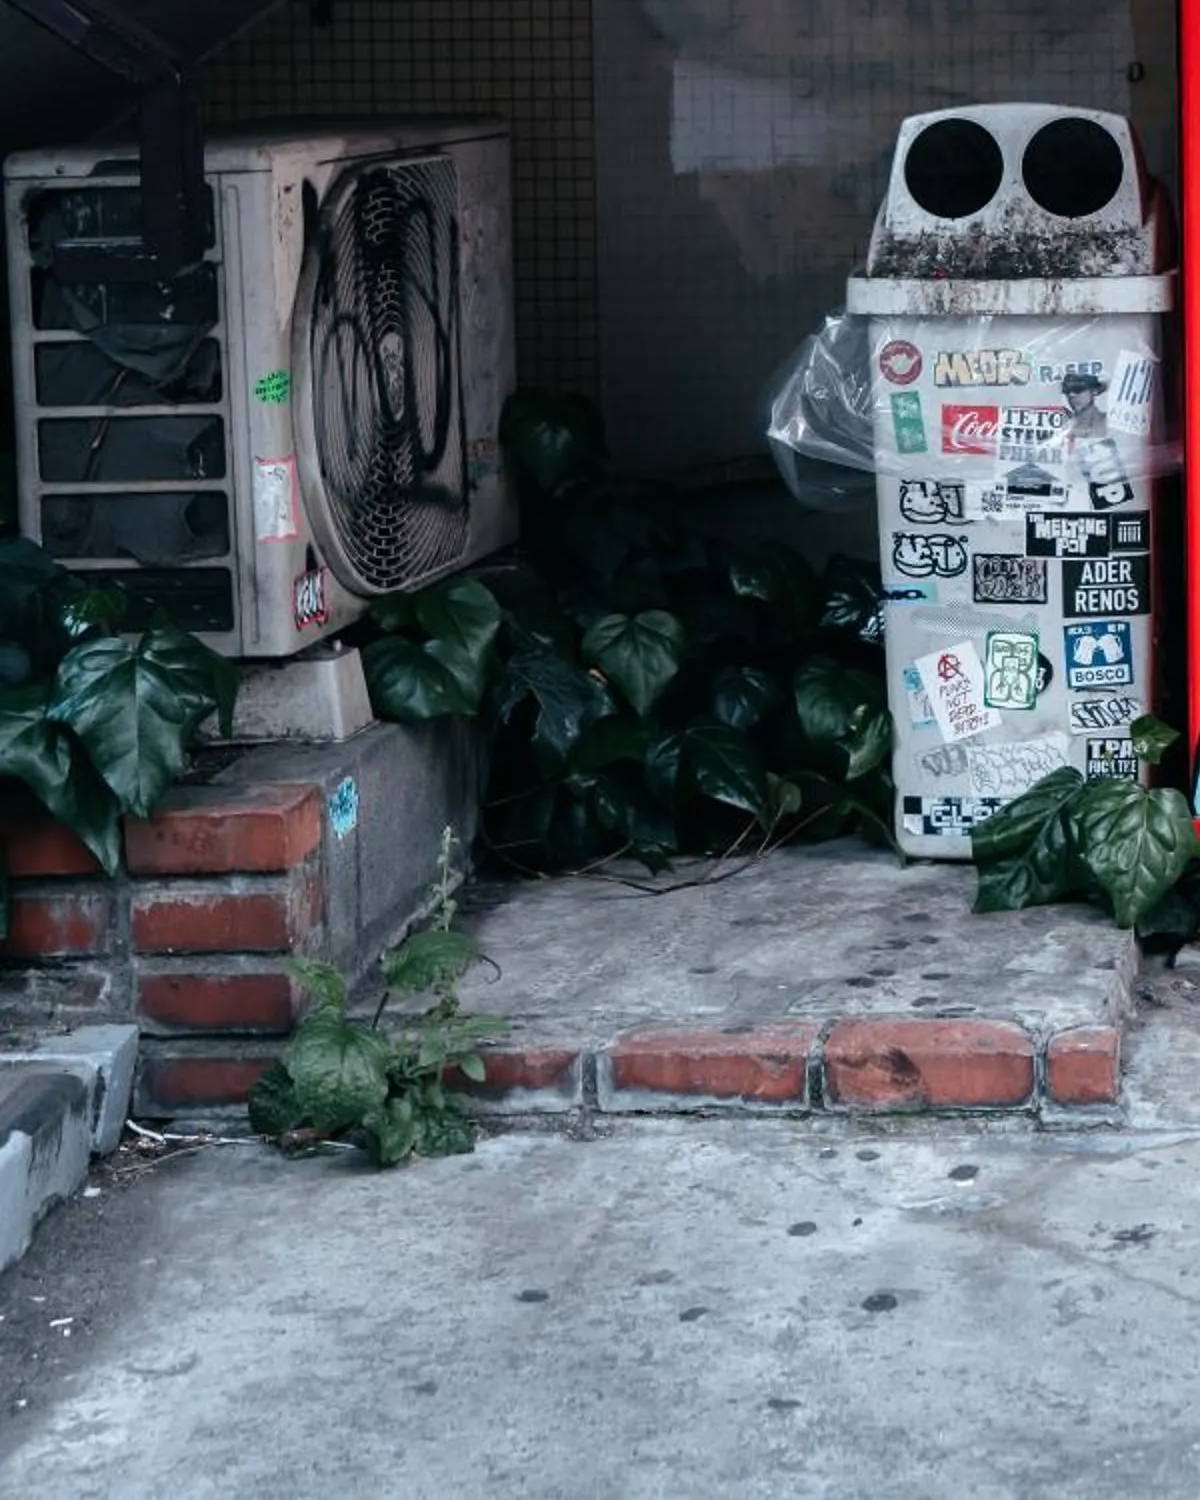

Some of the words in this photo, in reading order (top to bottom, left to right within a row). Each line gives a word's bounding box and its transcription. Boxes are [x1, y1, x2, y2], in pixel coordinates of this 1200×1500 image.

[1035, 517, 1108, 540] MELTING
[1055, 534, 1089, 557] POT
[1080, 560, 1133, 583] ADER
[1075, 589, 1139, 612] RENOS
[1075, 668, 1125, 683] BOSCO
